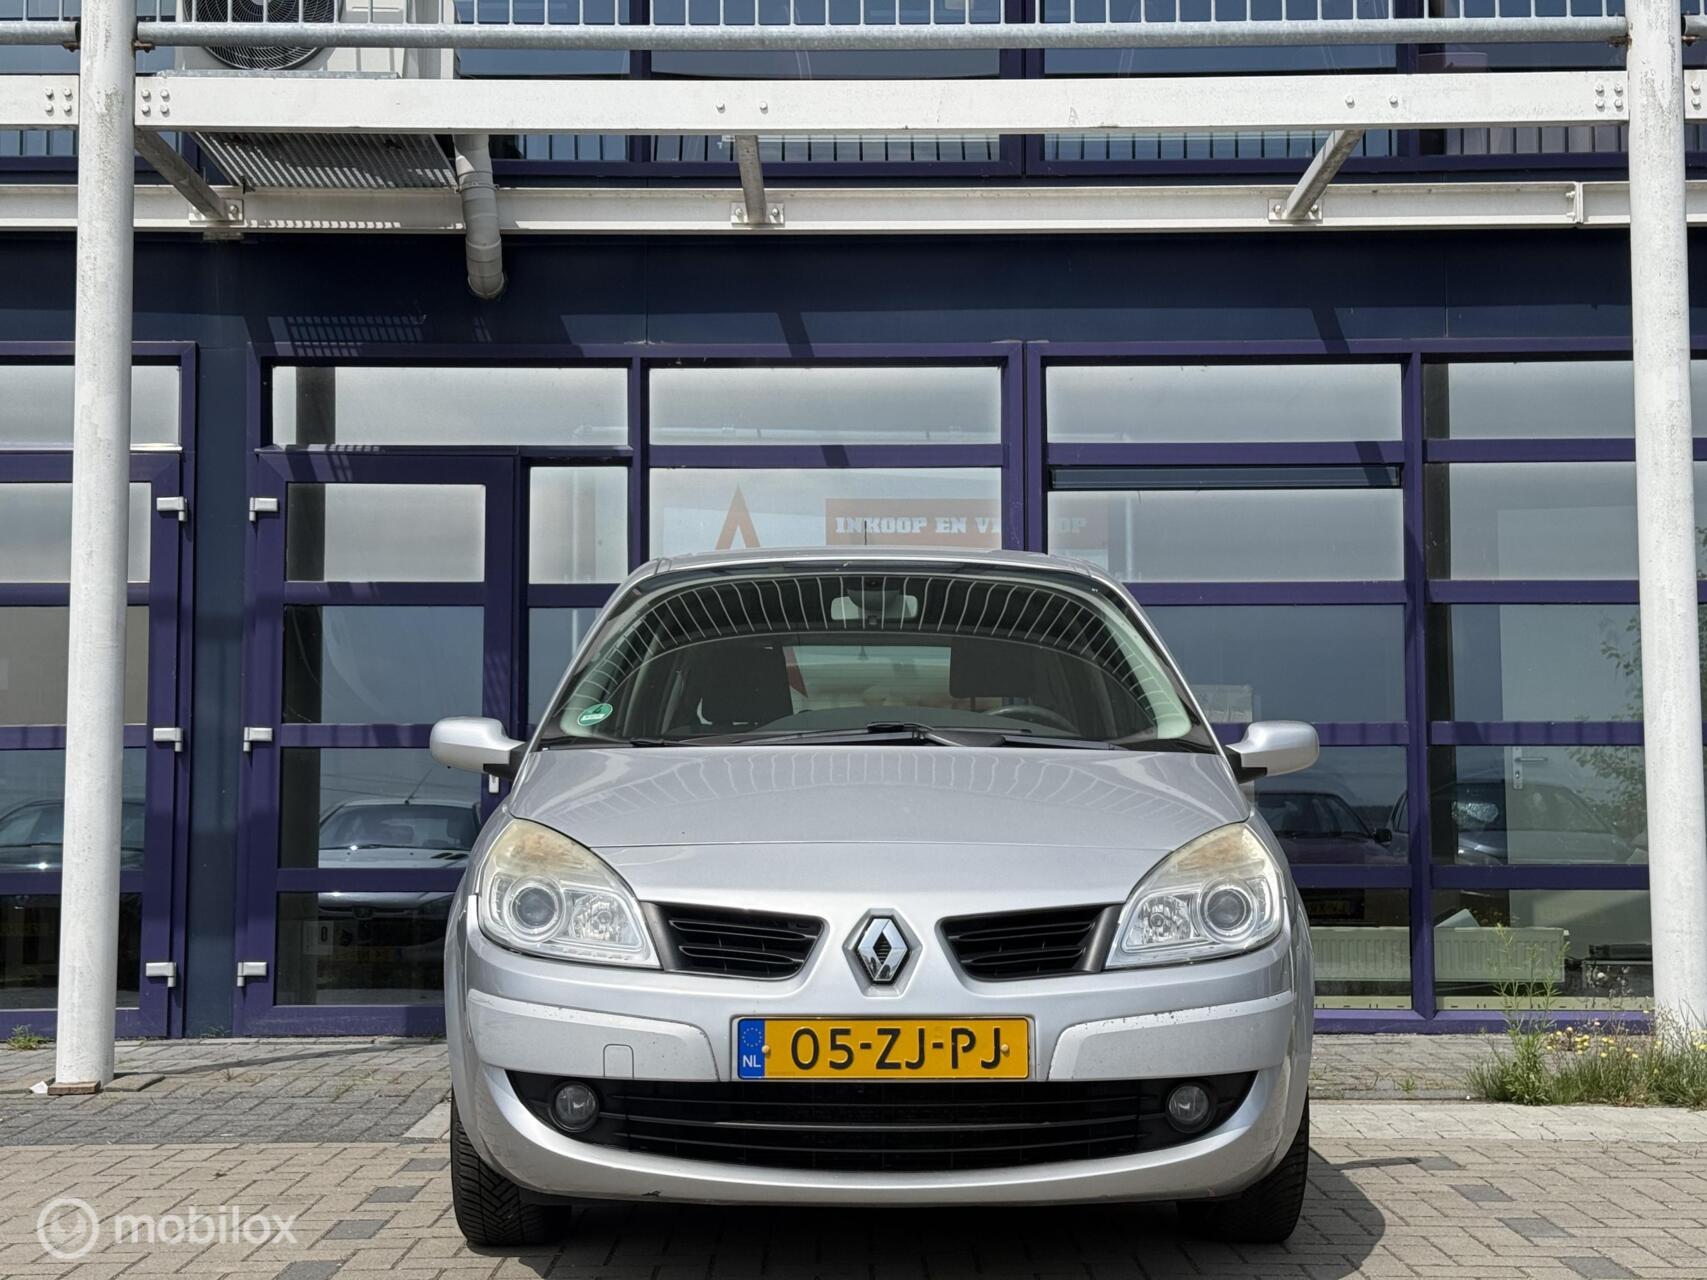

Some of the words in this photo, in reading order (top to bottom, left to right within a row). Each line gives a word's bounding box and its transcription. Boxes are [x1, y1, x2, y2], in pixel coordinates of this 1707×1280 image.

[834, 516, 927, 534] INKOOP
[935, 516, 967, 534] EN
[743, 1055, 761, 1068] NL
[790, 1026, 1001, 1070] 05-ZJ-PJ
